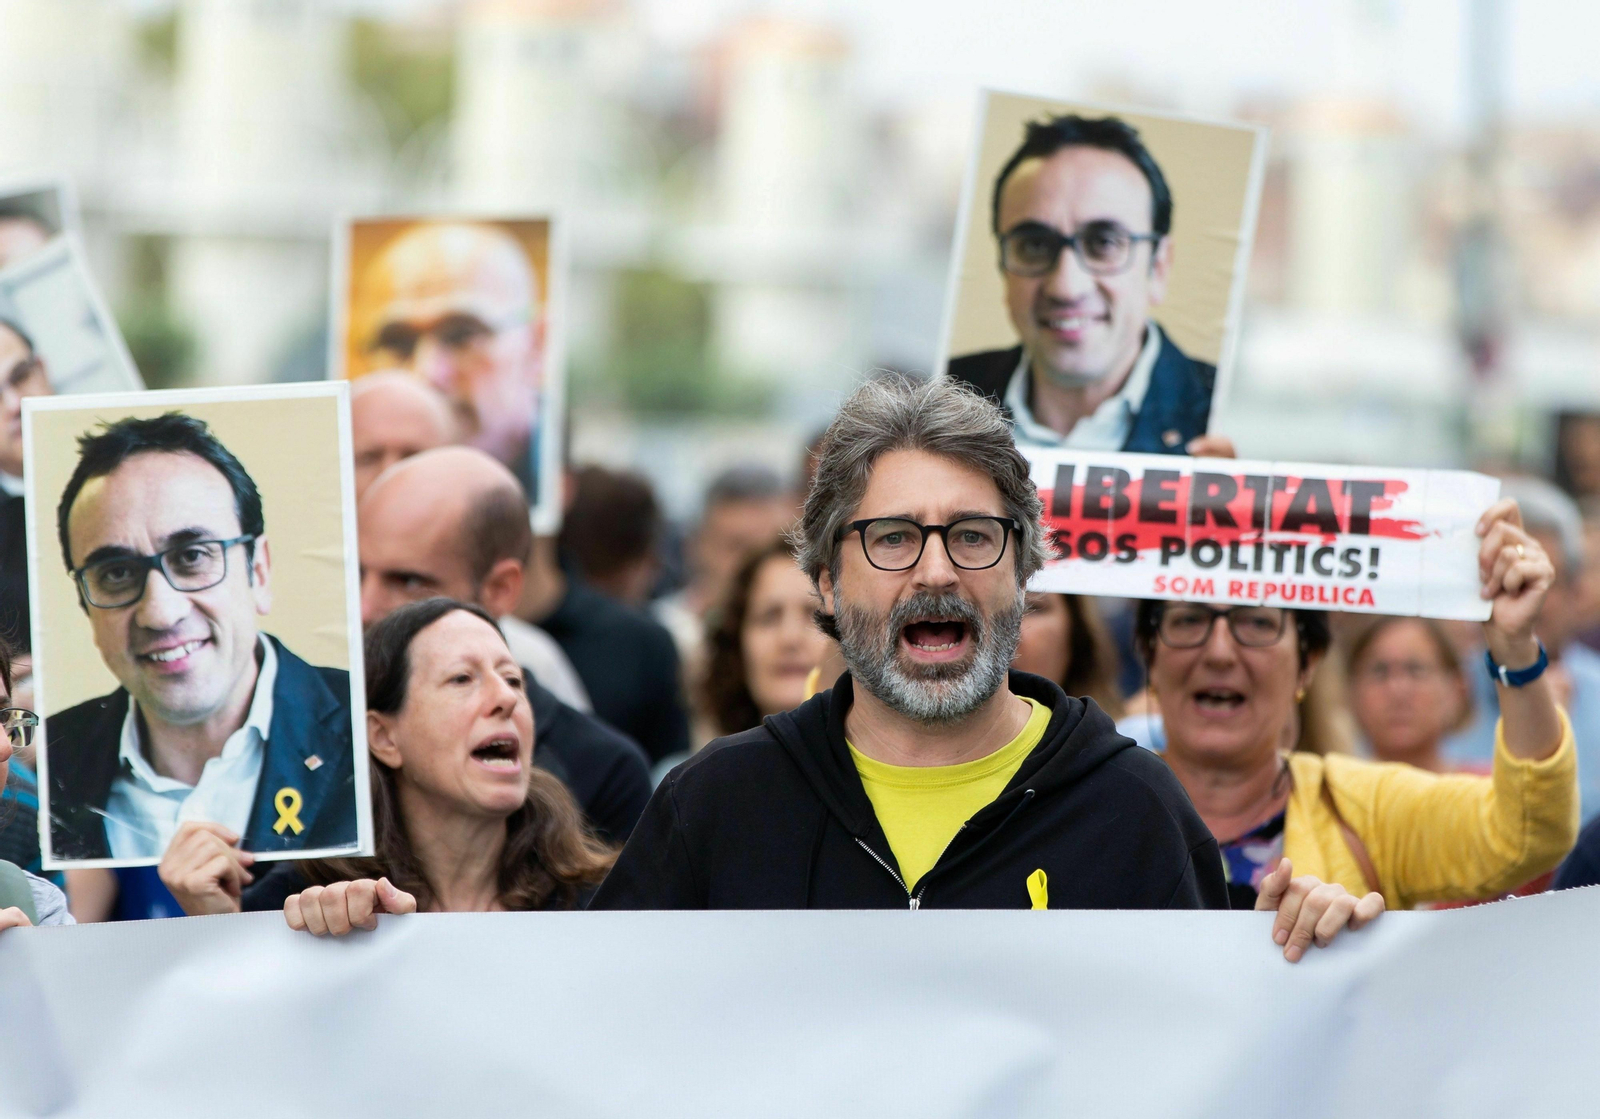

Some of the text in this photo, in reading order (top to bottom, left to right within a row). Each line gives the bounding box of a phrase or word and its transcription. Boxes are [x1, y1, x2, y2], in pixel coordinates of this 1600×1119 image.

[1030, 462, 1385, 536] IBERTAT
[1049, 529, 1380, 580] SOS POLÍTICS!
[1153, 575, 1376, 607] SOM REPÚBLICA
